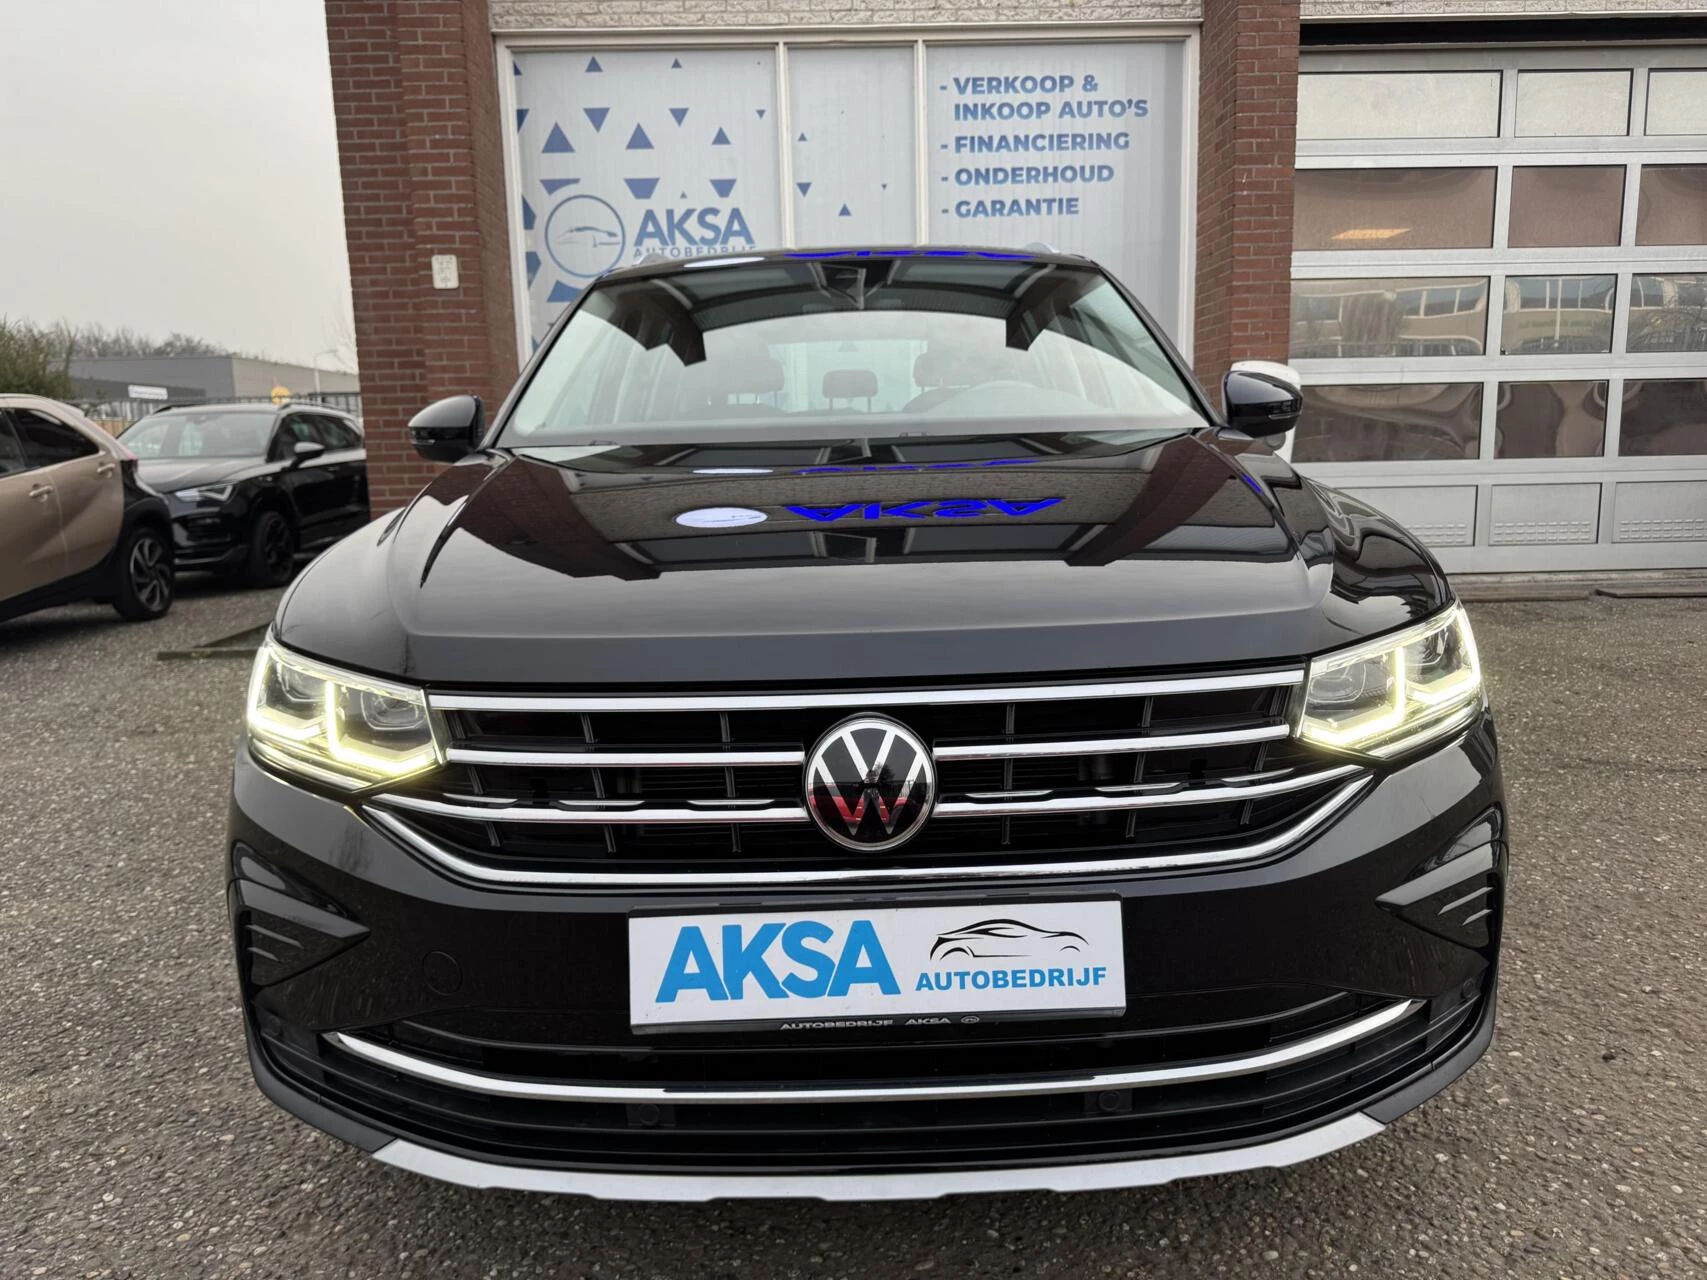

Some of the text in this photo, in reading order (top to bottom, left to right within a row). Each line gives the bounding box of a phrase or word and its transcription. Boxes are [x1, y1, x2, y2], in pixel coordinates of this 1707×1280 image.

[953, 75, 1075, 95] VERKOOP
[1081, 74, 1099, 93] &
[954, 98, 1149, 121] INKOOP AUTO'S
[954, 132, 1130, 154] FINANCIERING
[954, 164, 1115, 186] ONDERHOUD
[955, 197, 1080, 219] GARANTIE
[634, 206, 755, 247] AKSA
[655, 919, 902, 1004] AKSA
[915, 967, 1107, 992] AUTOBEDRIJF
[780, 1017, 951, 1030] AUTOBEDRIJF AKSA
